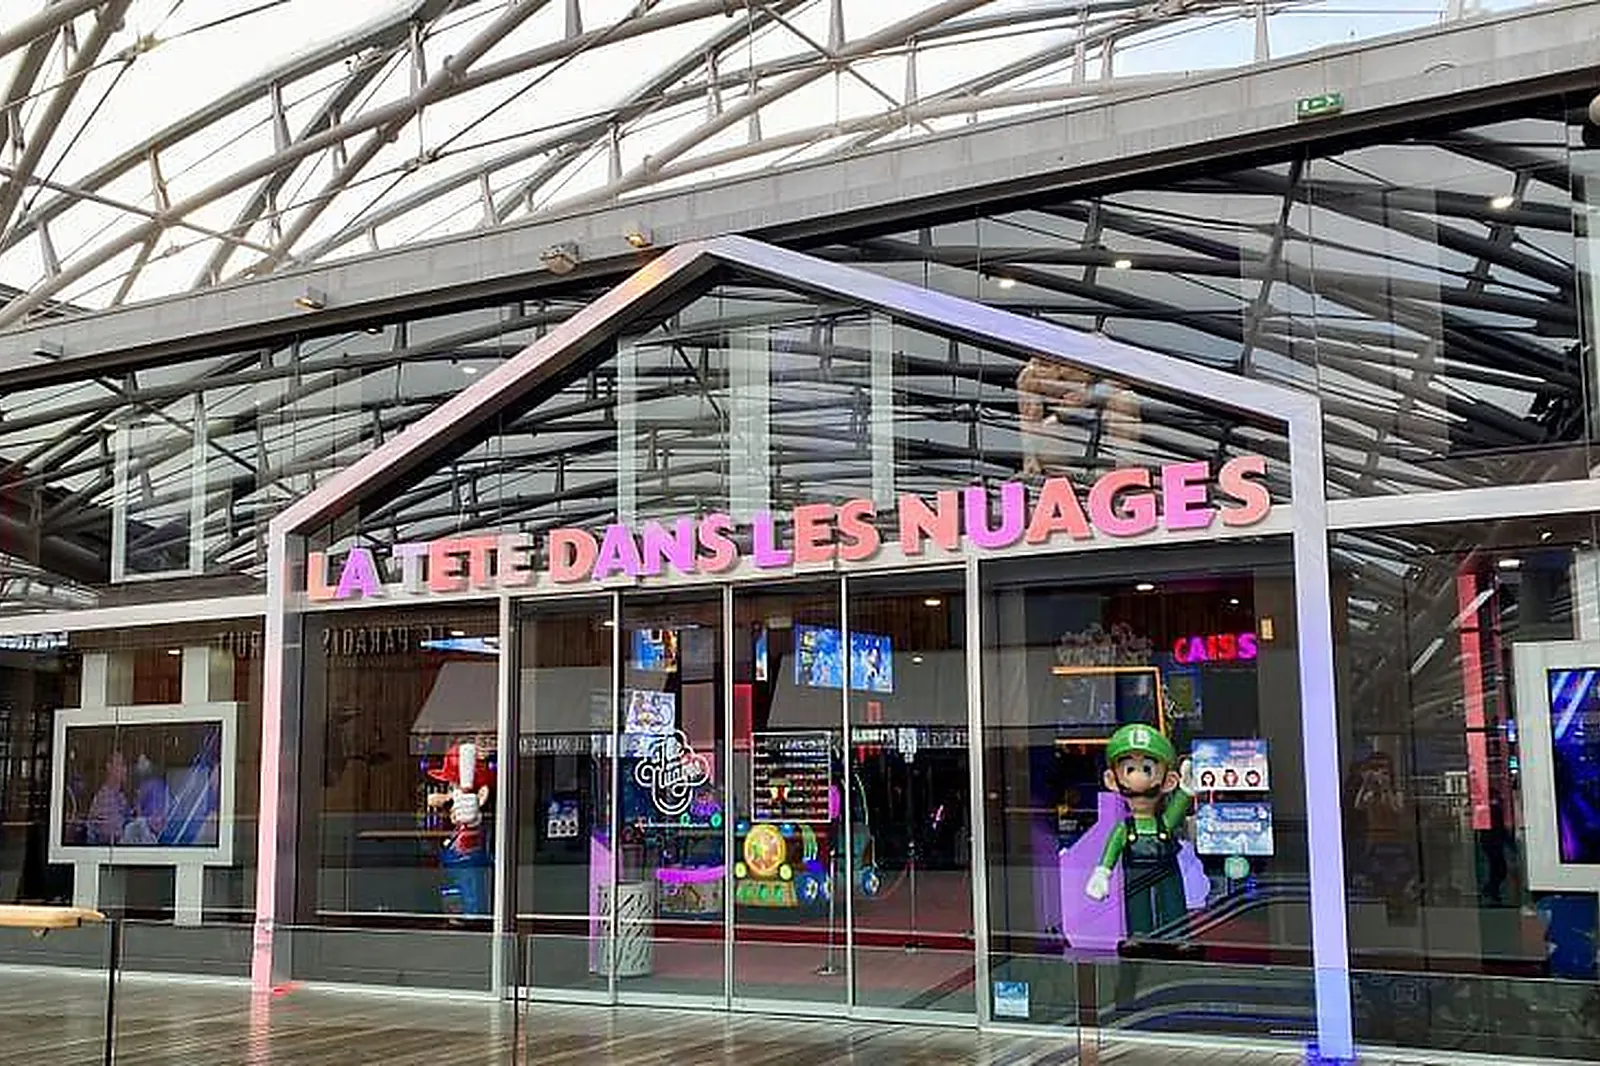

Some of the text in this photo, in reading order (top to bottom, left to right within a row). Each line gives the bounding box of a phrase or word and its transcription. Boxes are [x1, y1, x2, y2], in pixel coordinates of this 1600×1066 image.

[307, 546, 381, 601] LA
[549, 512, 737, 582] DANS
[753, 498, 880, 571] LES
[899, 455, 1271, 554] NUAGES
